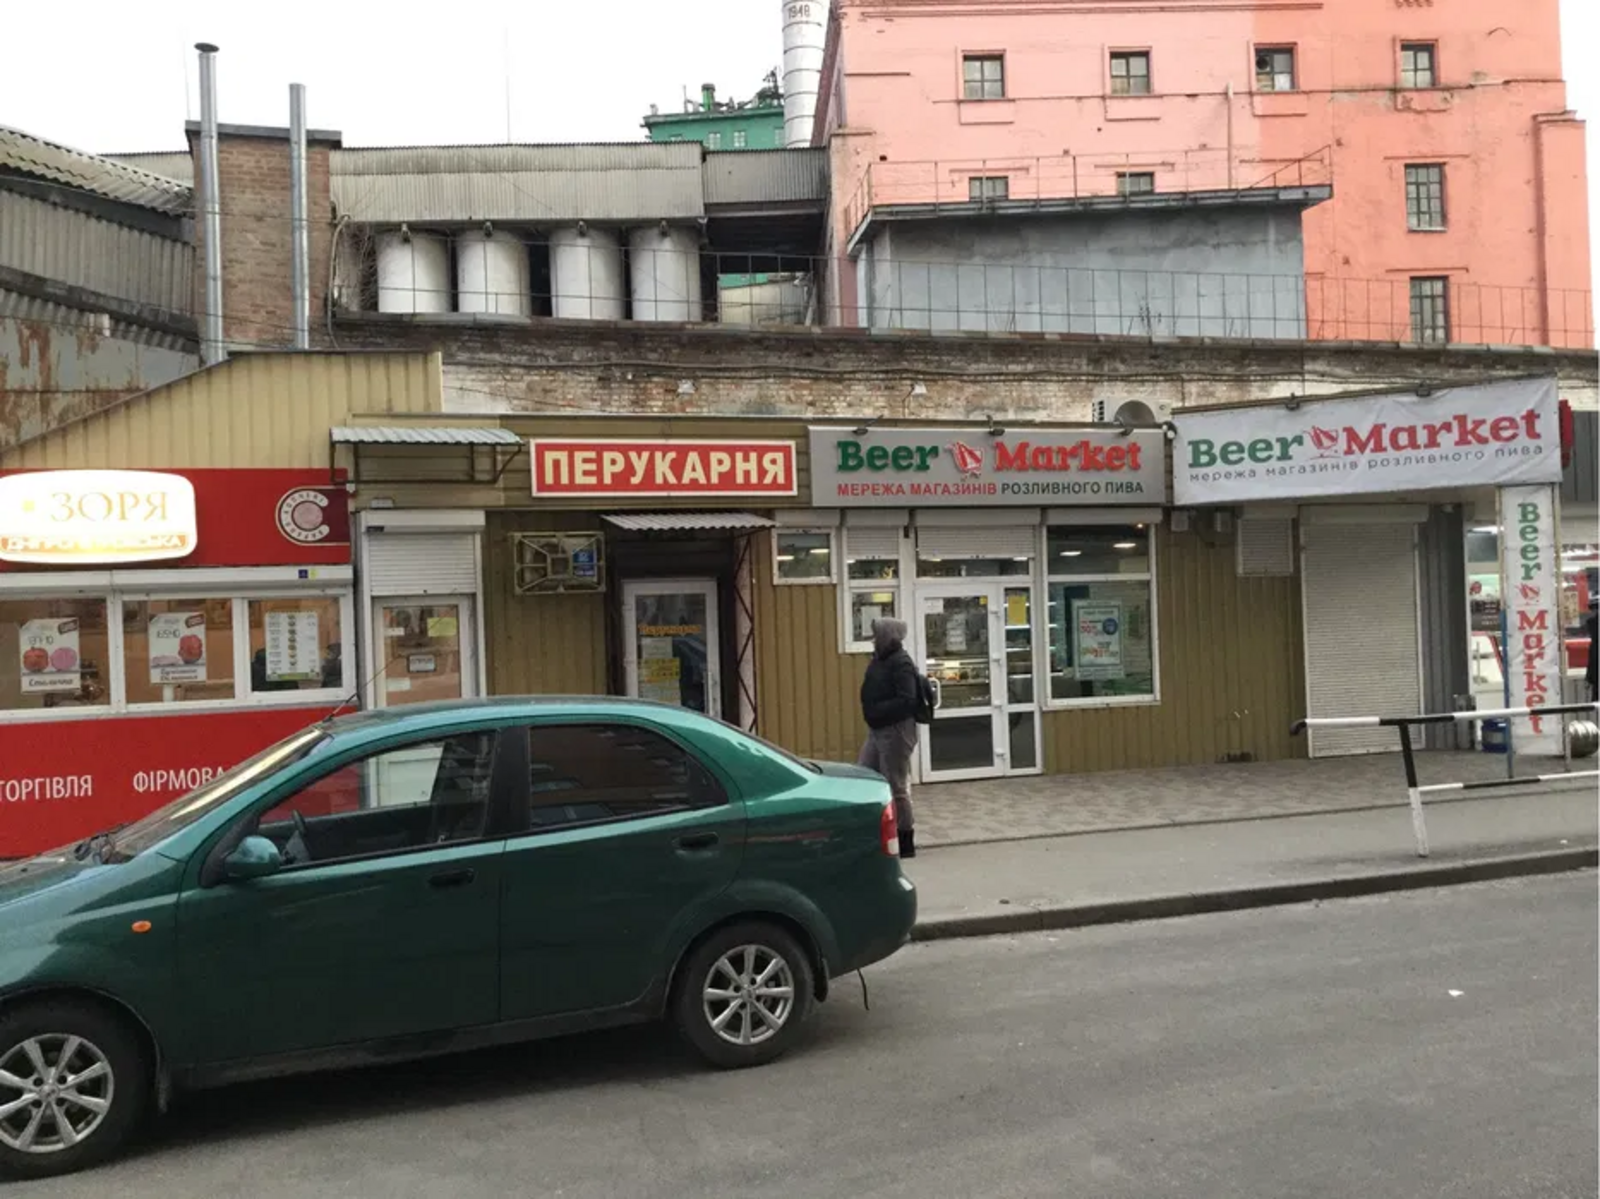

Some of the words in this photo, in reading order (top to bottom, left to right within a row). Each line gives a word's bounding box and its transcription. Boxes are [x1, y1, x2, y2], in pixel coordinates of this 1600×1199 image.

[837, 440, 939, 472] Beer
[994, 440, 1142, 472] Market
[1187, 434, 1304, 468] Beer
[1342, 408, 1542, 456] Market
[544, 450, 785, 485] ПЕРУКАРНЯ
[1190, 469, 1257, 482] мережа
[1266, 459, 1359, 476] магазинів
[1368, 450, 1485, 470] розливного
[1495, 444, 1543, 459] пива
[837, 483, 906, 496] МЕРЕЖА
[910, 483, 997, 495] МАГАЗИНІВ
[1001, 482, 1101, 495] РОЗЛИВНОГО
[1105, 481, 1144, 494] ПИВА
[51, 492, 168, 522] ЗОРЯ
[1517, 503, 1541, 580] Beer
[1516, 609, 1549, 734] Market
